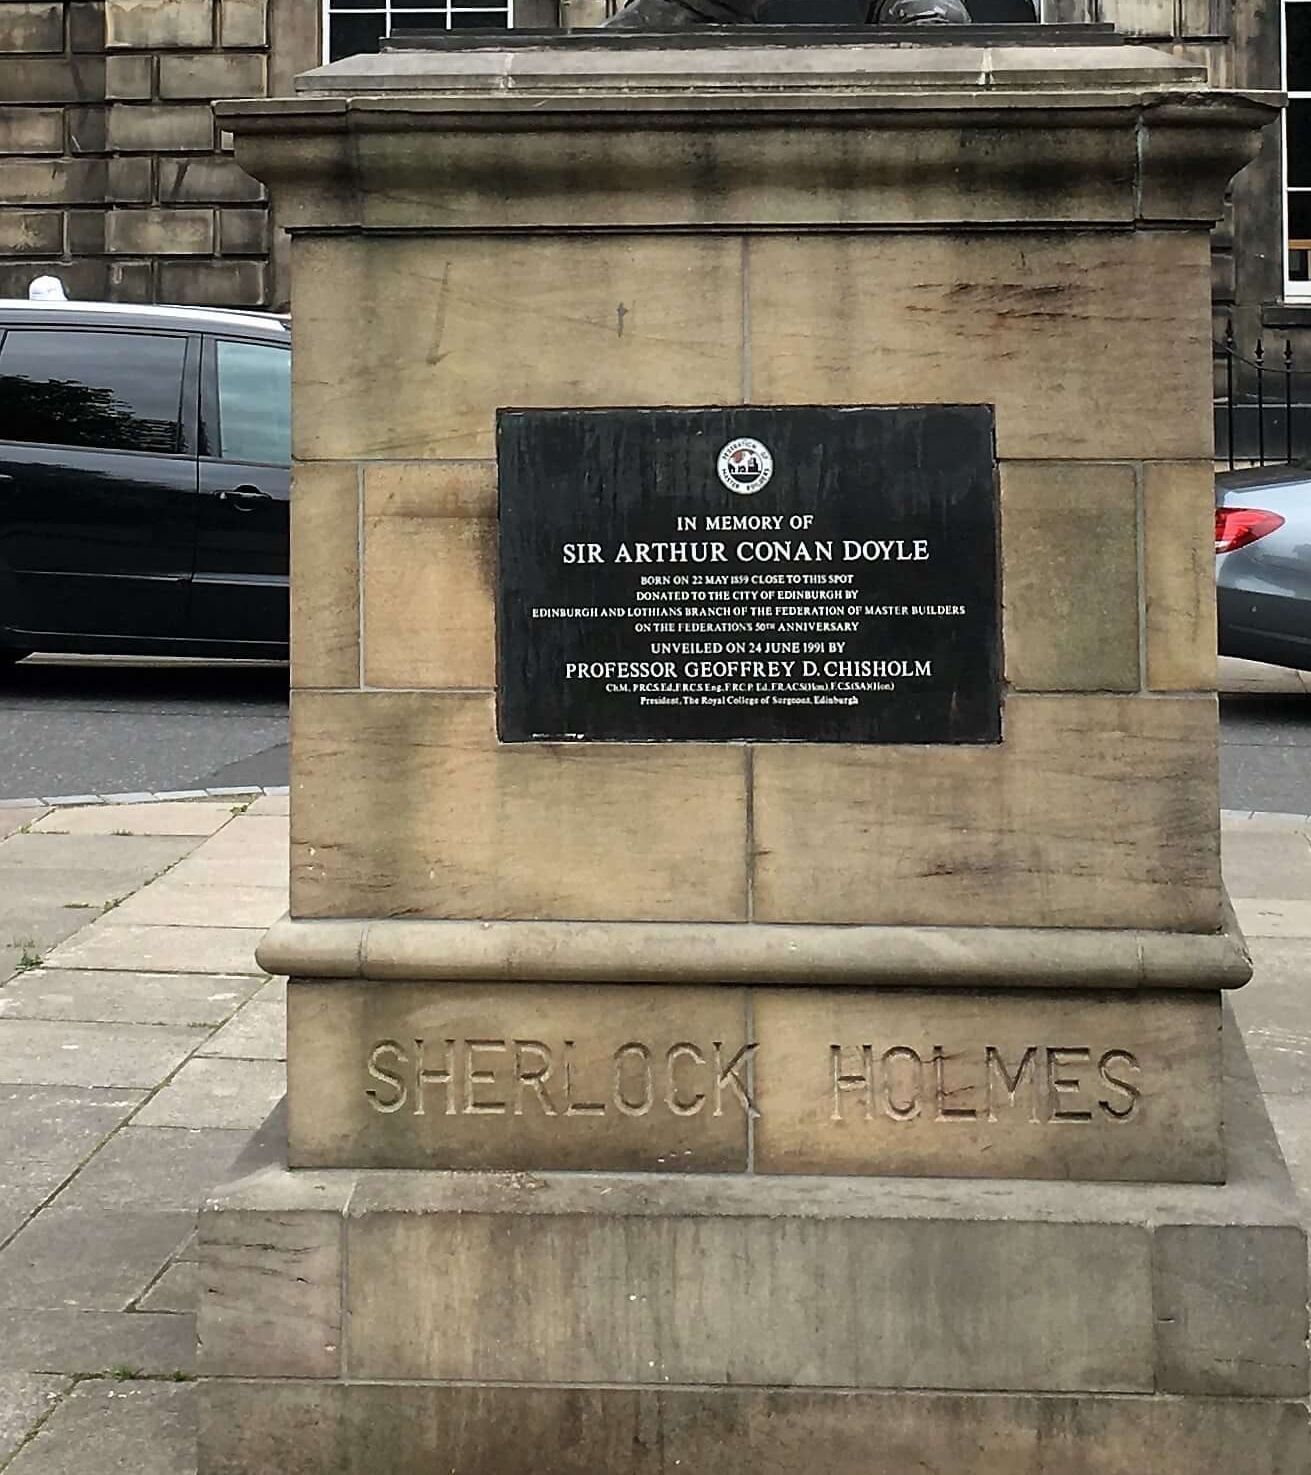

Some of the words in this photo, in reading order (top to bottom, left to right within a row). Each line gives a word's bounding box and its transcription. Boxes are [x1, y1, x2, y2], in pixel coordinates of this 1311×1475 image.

[676, 516, 697, 531] IN
[705, 515, 784, 531] MEMORY
[790, 515, 814, 530] OF
[563, 543, 605, 564] SIR
[614, 541, 728, 563] ARTHUR
[737, 540, 833, 562] CONAN
[843, 539, 930, 562] DOYLE
[641, 576, 670, 585] BORN
[673, 576, 689, 585] ON
[691, 576, 703, 585] 22
[705, 575, 728, 585] MAY
[751, 575, 785, 584] CLOSE
[786, 575, 801, 584] TO
[803, 575, 827, 584] THIS
[828, 575, 854, 584] SPOT
[636, 591, 689, 601] DONATED
[690, 591, 706, 601] TO
[708, 591, 730, 601] THE
[732, 591, 758, 601] CITY
[760, 590, 775, 600] OF
[777, 590, 842, 600] EDINBURGH
[845, 590, 859, 600] BY
[532, 608, 598, 618] EDINBURGH
[600, 608, 625, 617] AND
[627, 607, 683, 617] LOTHIANS
[685, 607, 731, 617] BRANCH
[733, 607, 748, 616] OF
[750, 606, 772, 616] THE
[775, 606, 844, 616] FEDERATION
[847, 605, 862, 616] OF
[864, 605, 909, 615] MASTER
[911, 605, 966, 615] BUILDERS
[635, 623, 651, 633] ON
[652, 623, 675, 632] THE
[755, 623, 775, 632] 50TH
[778, 622, 859, 632] ANNIVERSARY
[651, 643, 723, 654] UNVEILED
[726, 642, 746, 653] ON
[748, 642, 762, 653] 24
[764, 642, 800, 653] JUNE
[803, 642, 825, 653] 1991
[828, 642, 846, 653] BY
[566, 662, 678, 678] PROFESSOR
[685, 661, 795, 678] GEOFFREY
[803, 661, 820, 677] D.
[823, 660, 932, 677] CHISHOLM
[682, 696, 699, 705] The
[701, 696, 725, 707] Royal
[726, 696, 759, 706] College
[761, 696, 770, 705] of
[814, 695, 859, 706] Edinburgh
[366, 1038, 760, 1117] SHERLOCK
[830, 1044, 1141, 1124] HOLMES
